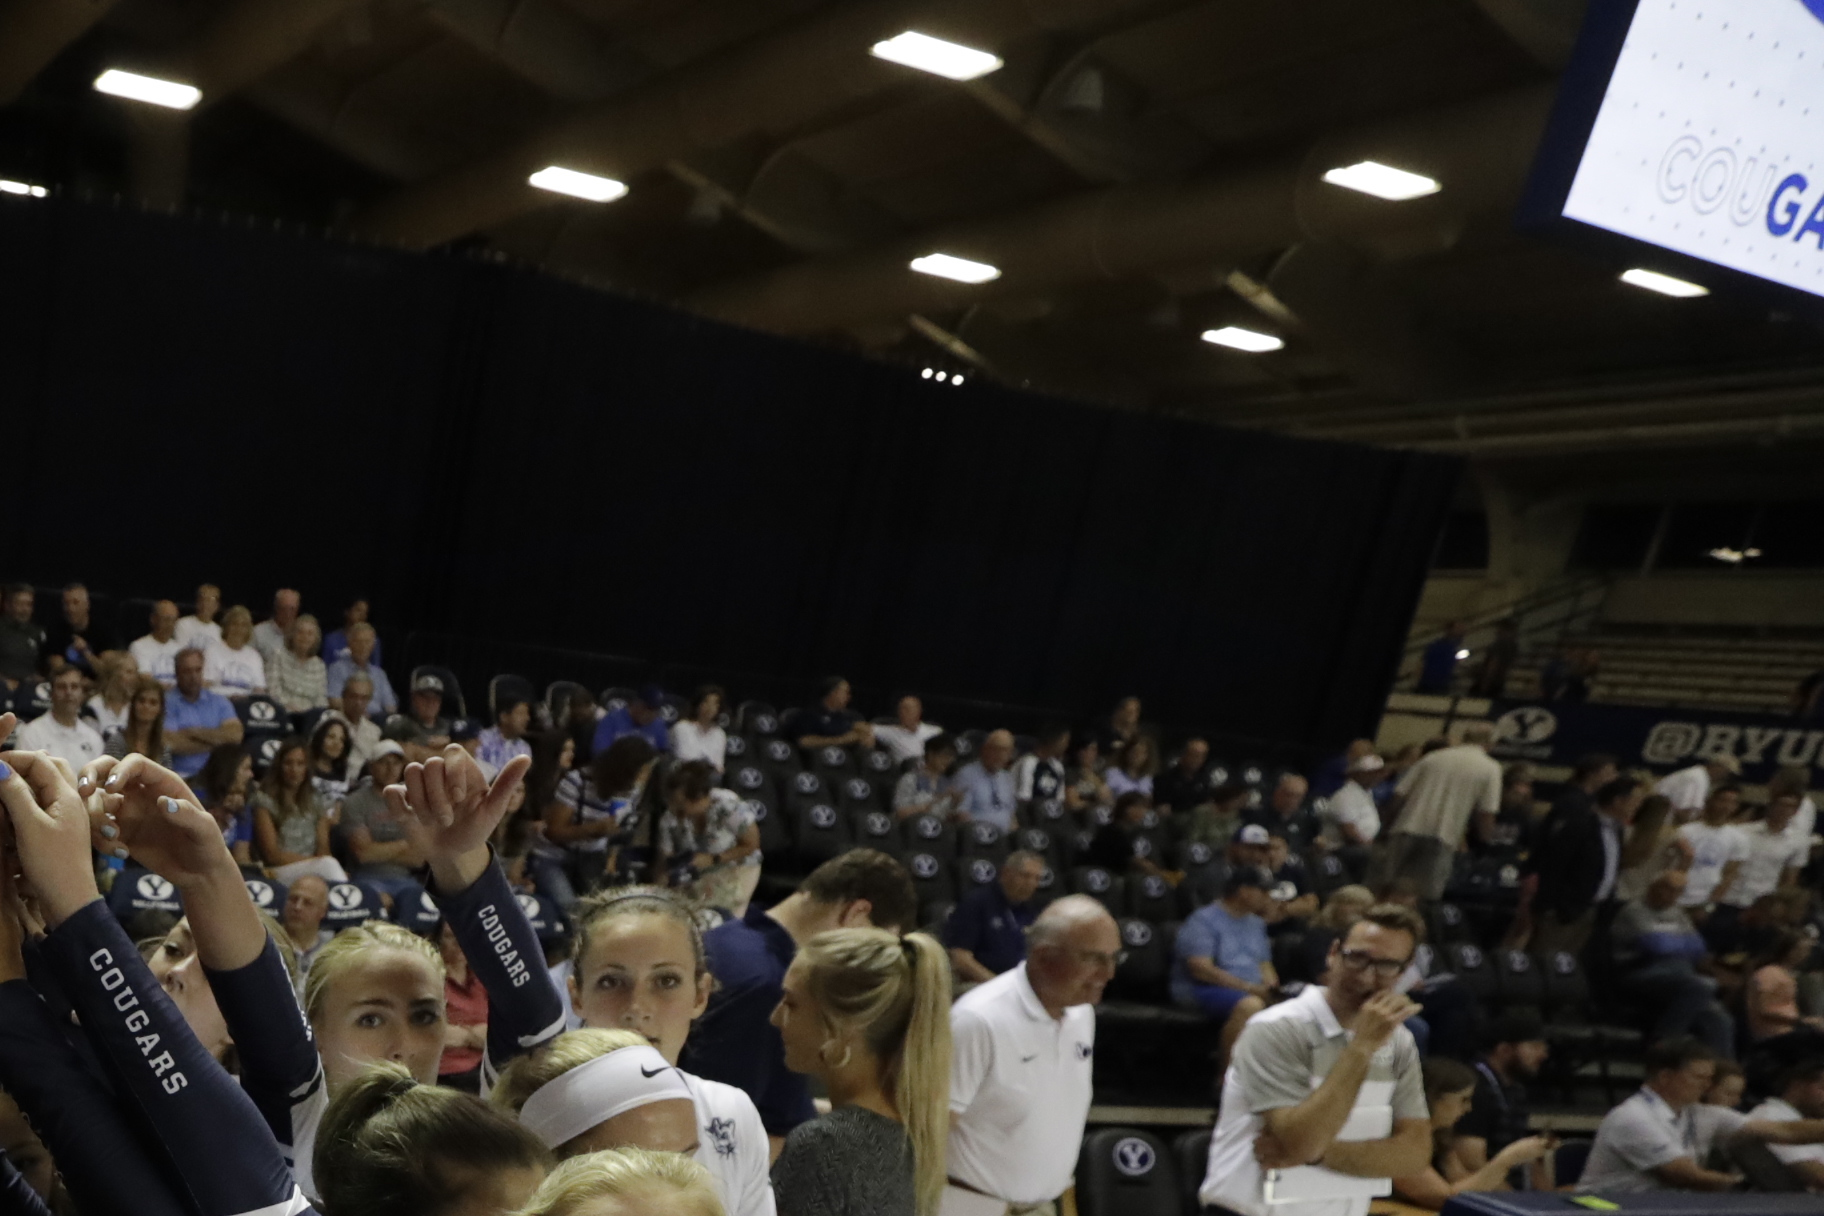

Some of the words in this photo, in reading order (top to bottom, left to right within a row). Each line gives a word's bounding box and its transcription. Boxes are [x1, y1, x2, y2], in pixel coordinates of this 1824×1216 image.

[1642, 721, 1824, 767] @BYU
[478, 904, 531, 989] COUGARS
[89, 947, 189, 1095] COUGARS
